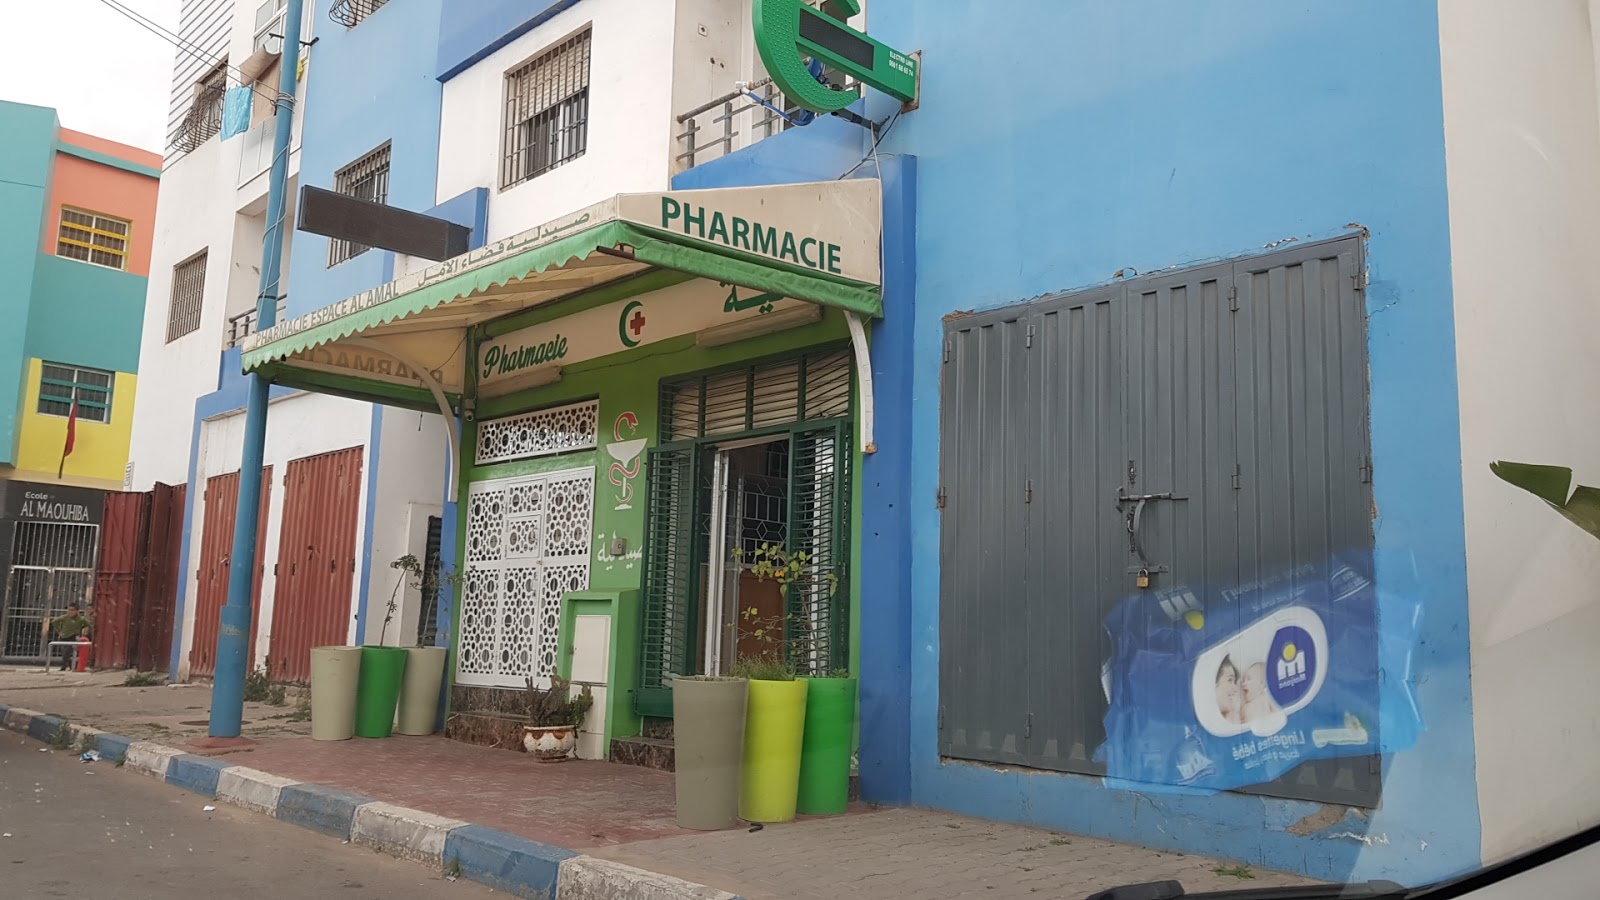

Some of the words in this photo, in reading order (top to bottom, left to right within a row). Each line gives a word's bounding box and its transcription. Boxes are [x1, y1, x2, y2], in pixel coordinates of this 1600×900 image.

[506, 211, 591, 252] صيدلية
[661, 196, 842, 275] PHARMACIE
[417, 257, 458, 288] الأمل
[461, 239, 505, 270] فضاء
[254, 314, 309, 347] PHARMACIE
[311, 301, 347, 326] ESPACE
[351, 294, 365, 315] AL
[366, 279, 399, 307] AMAL
[482, 333, 569, 379] Pharmacie
[20, 500, 34, 517] AL
[36, 501, 90, 522] MAOUHIBA
[25, 491, 49, 500] Ecole
